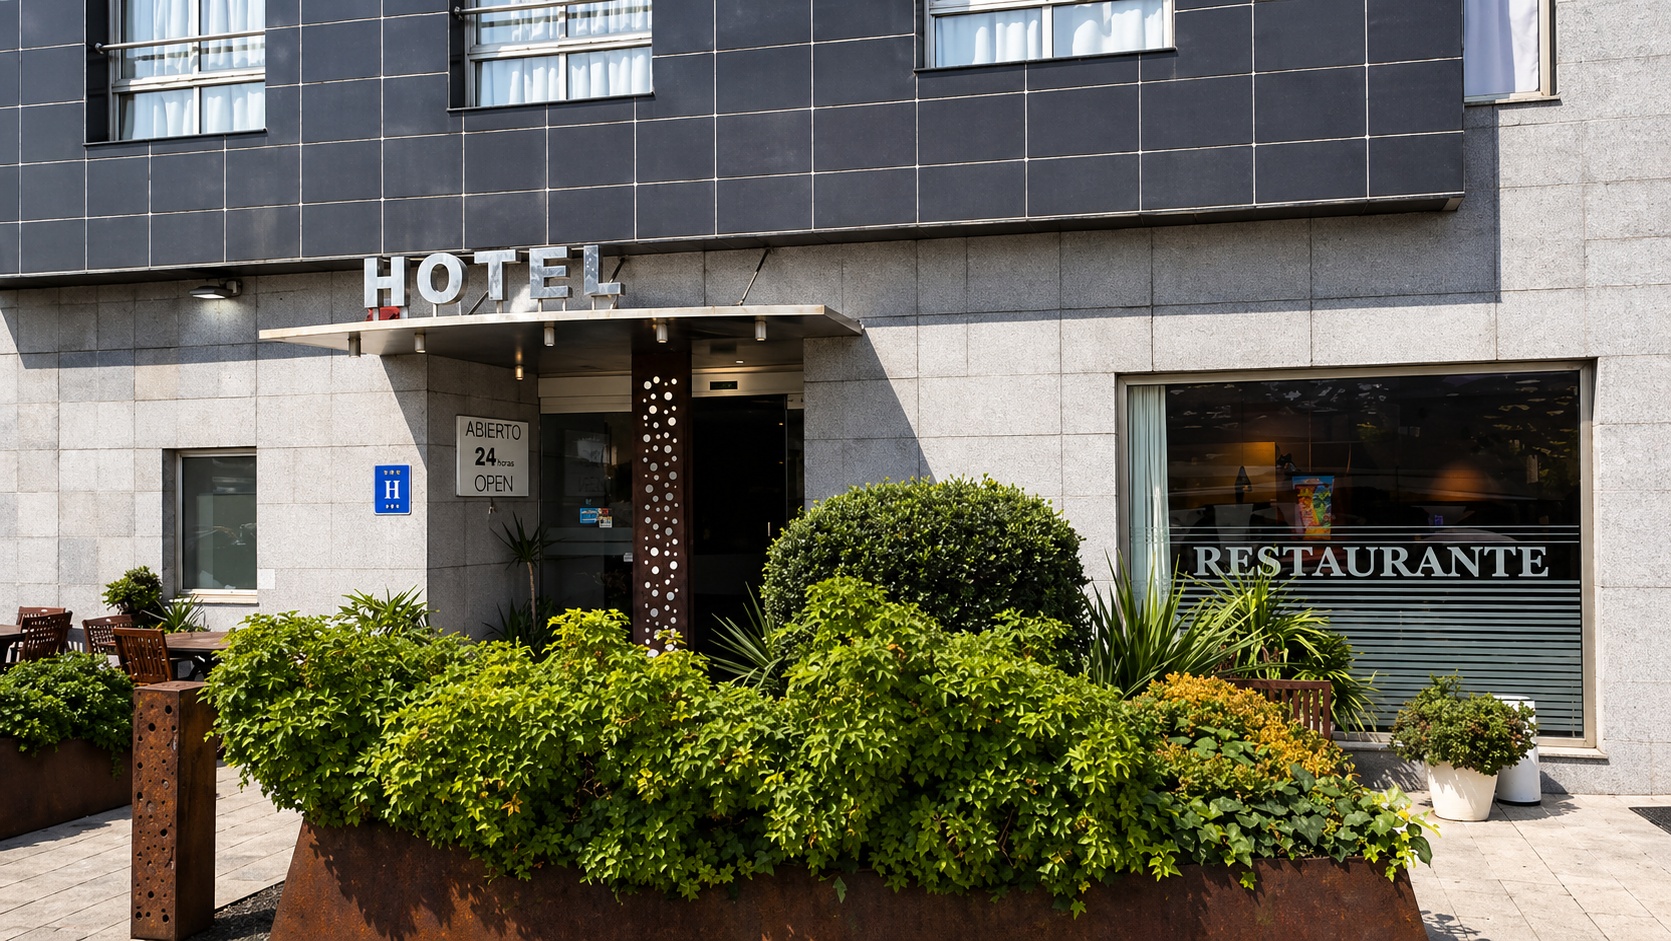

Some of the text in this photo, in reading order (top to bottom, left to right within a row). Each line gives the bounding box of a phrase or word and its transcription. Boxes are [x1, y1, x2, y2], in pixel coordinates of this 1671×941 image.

[364, 245, 625, 308] HOTEL
[465, 421, 521, 440] ABIERTO
[475, 447, 514, 467] 24 horas
[384, 480, 400, 499] H
[474, 475, 513, 492] OPEN
[1193, 546, 1549, 577] RESTAURANTE
